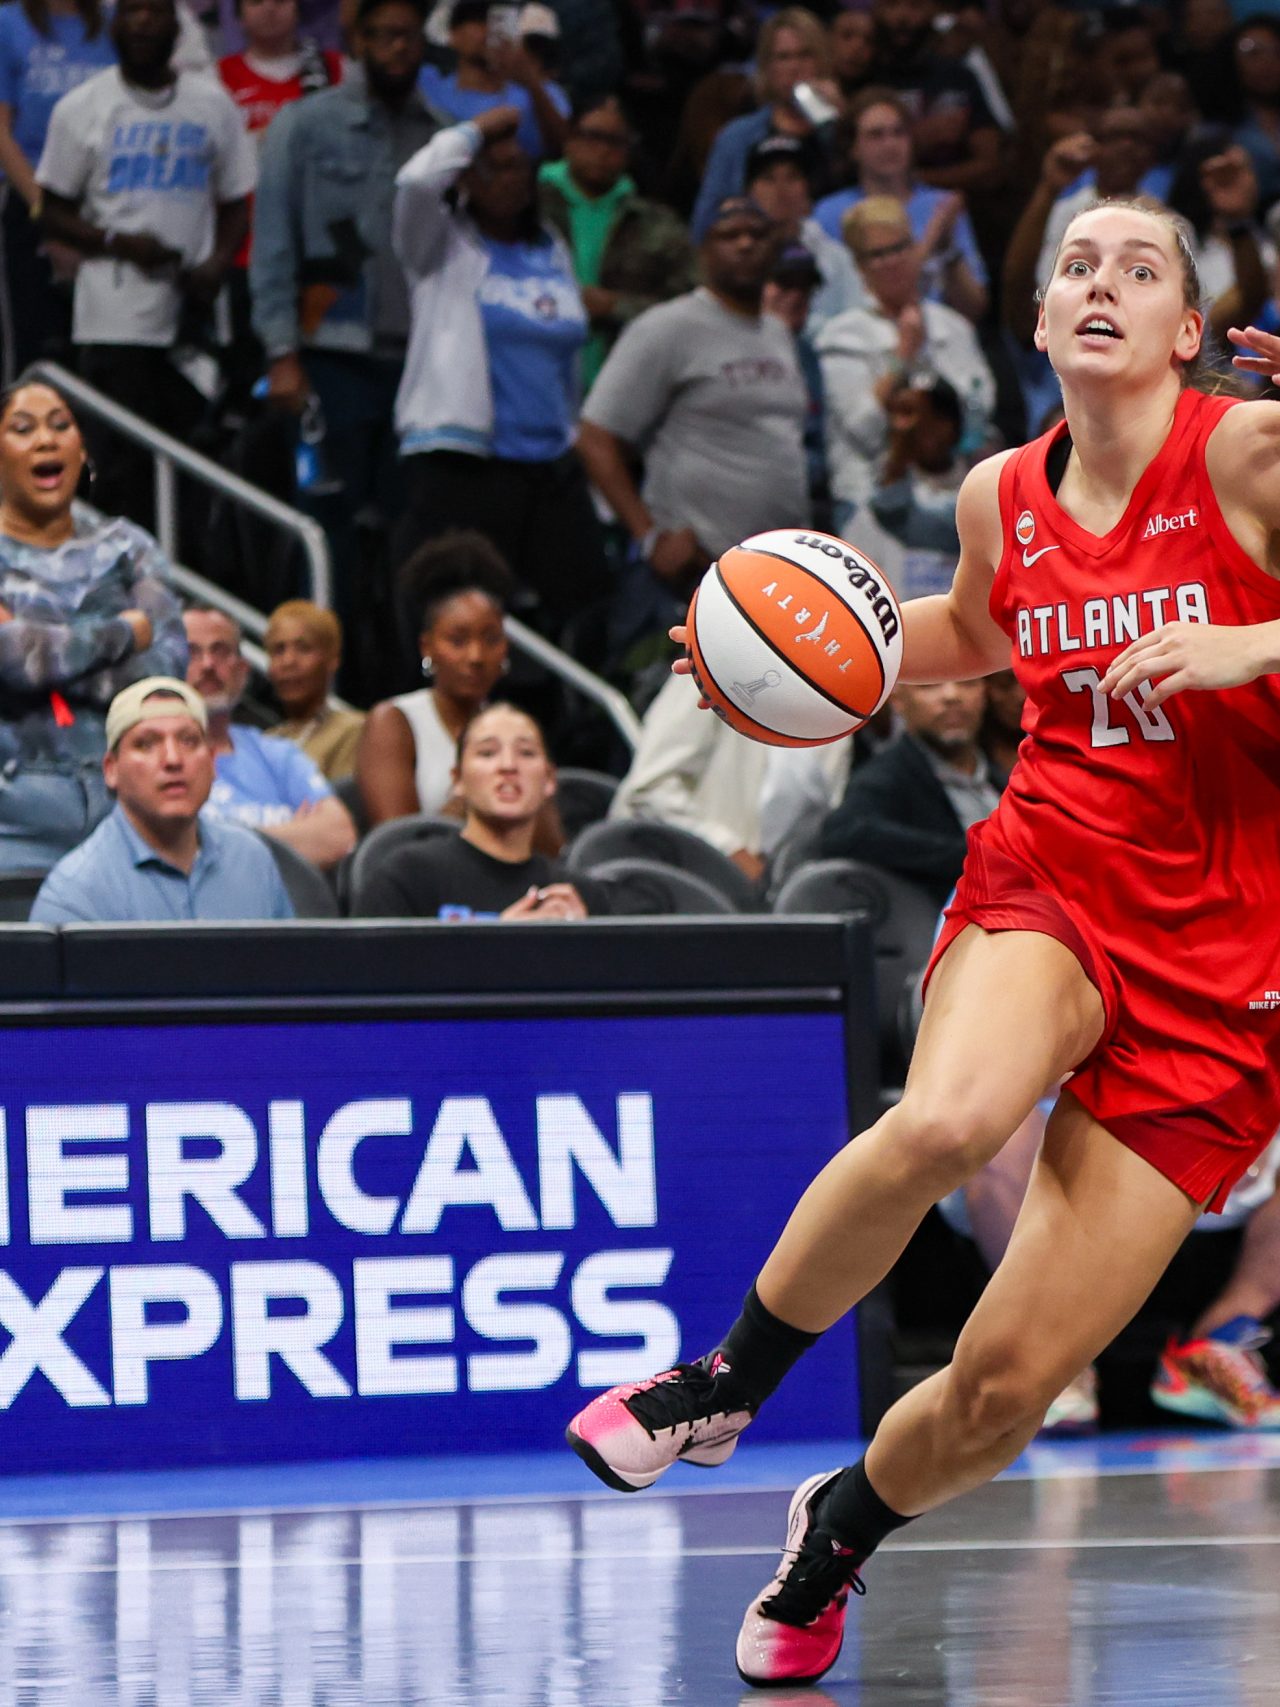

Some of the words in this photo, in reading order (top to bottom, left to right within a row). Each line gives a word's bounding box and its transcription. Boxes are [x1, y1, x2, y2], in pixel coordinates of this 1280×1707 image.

[1143, 508, 1198, 538] Albert
[794, 534, 899, 648] Wilson
[1017, 582, 1212, 657] ATLANTA
[0, 1092, 658, 1246] ERICAN
[0, 1248, 682, 1408] XPRESS
